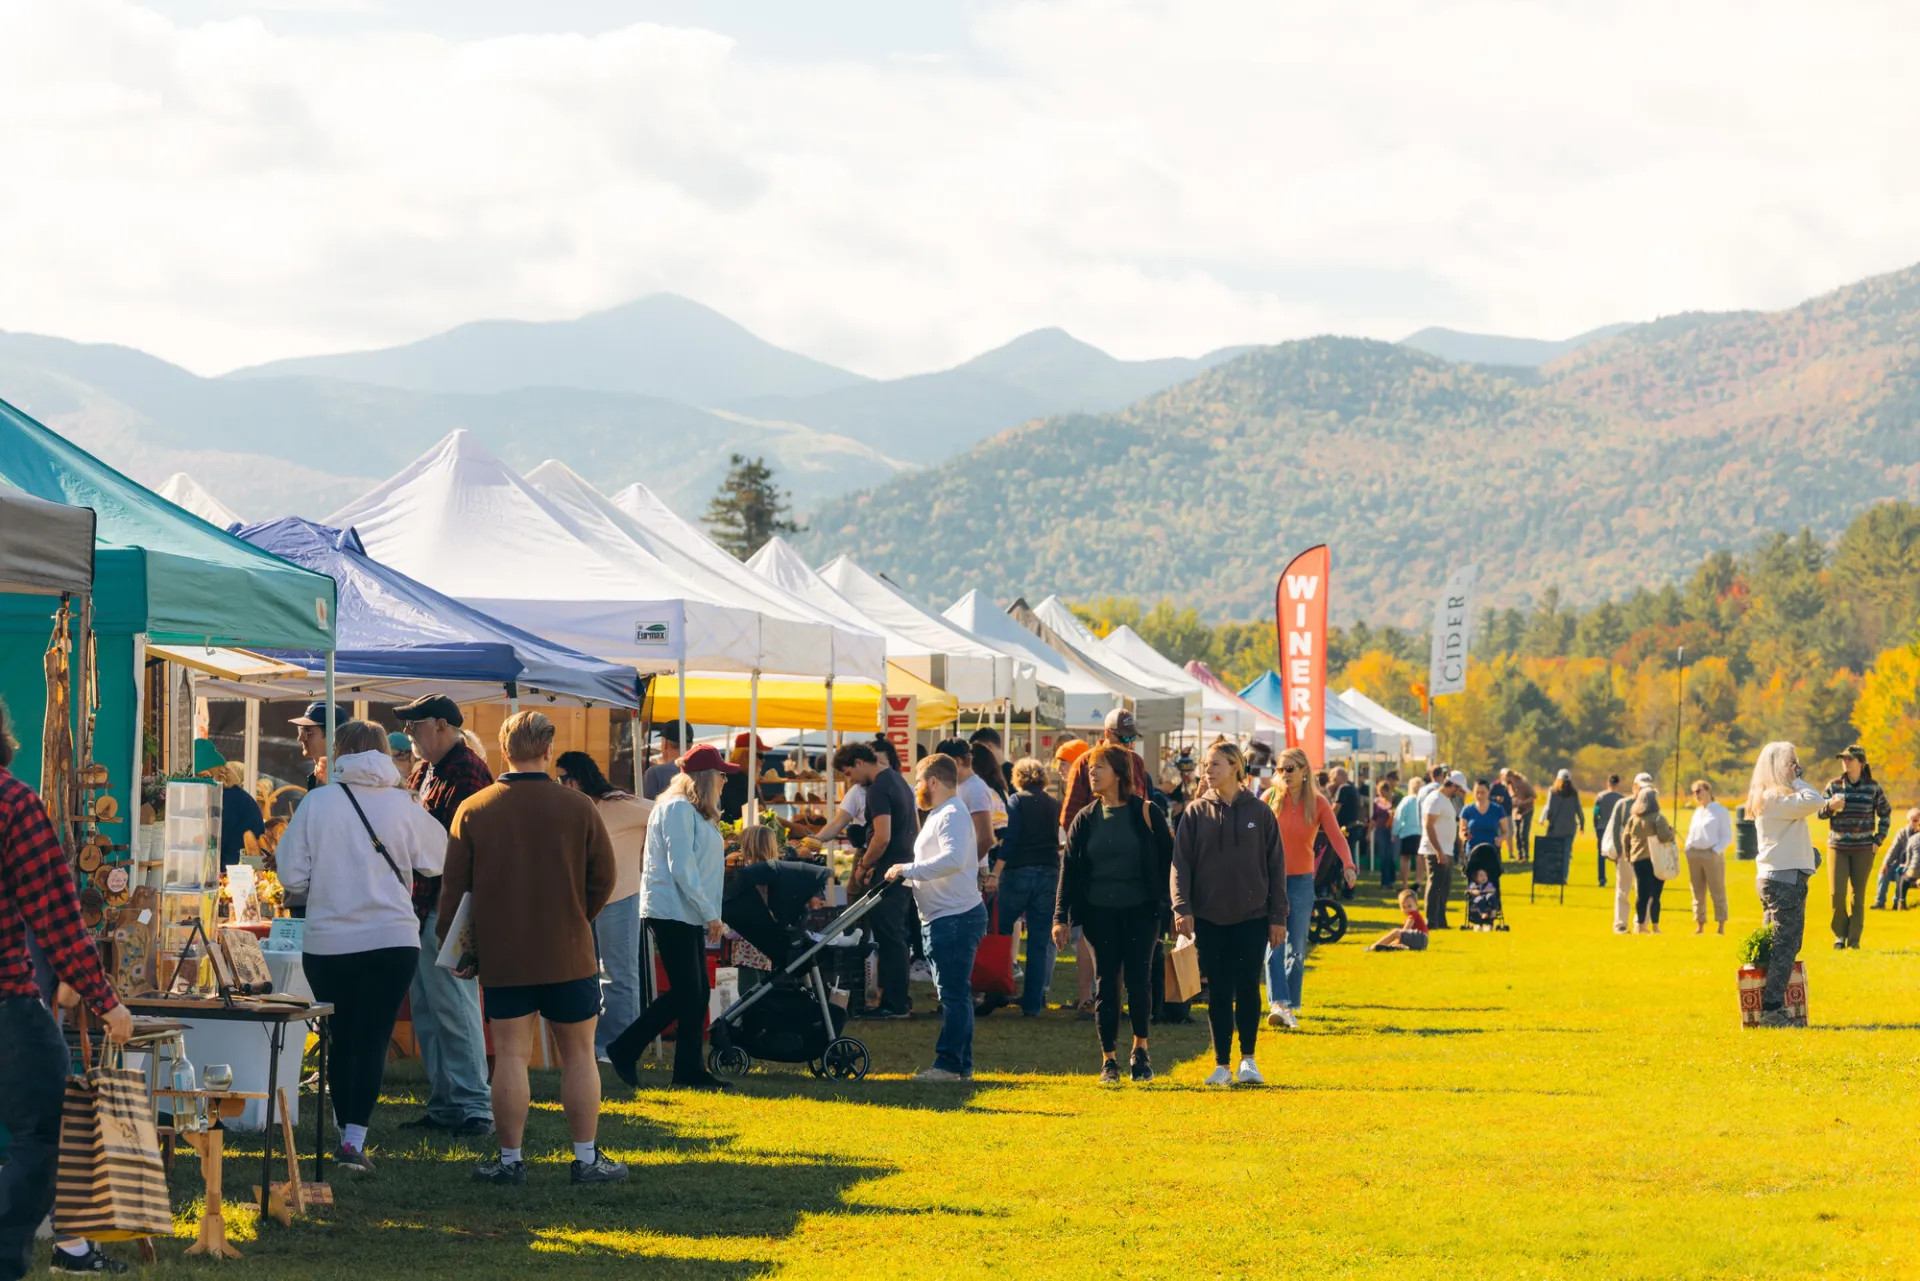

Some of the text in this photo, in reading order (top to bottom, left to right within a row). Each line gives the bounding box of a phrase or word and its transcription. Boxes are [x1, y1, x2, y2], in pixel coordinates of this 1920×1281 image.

[1286, 575, 1319, 740] WINERY
[1443, 595, 1465, 683] CIDER
[887, 697, 911, 773] VEGE
